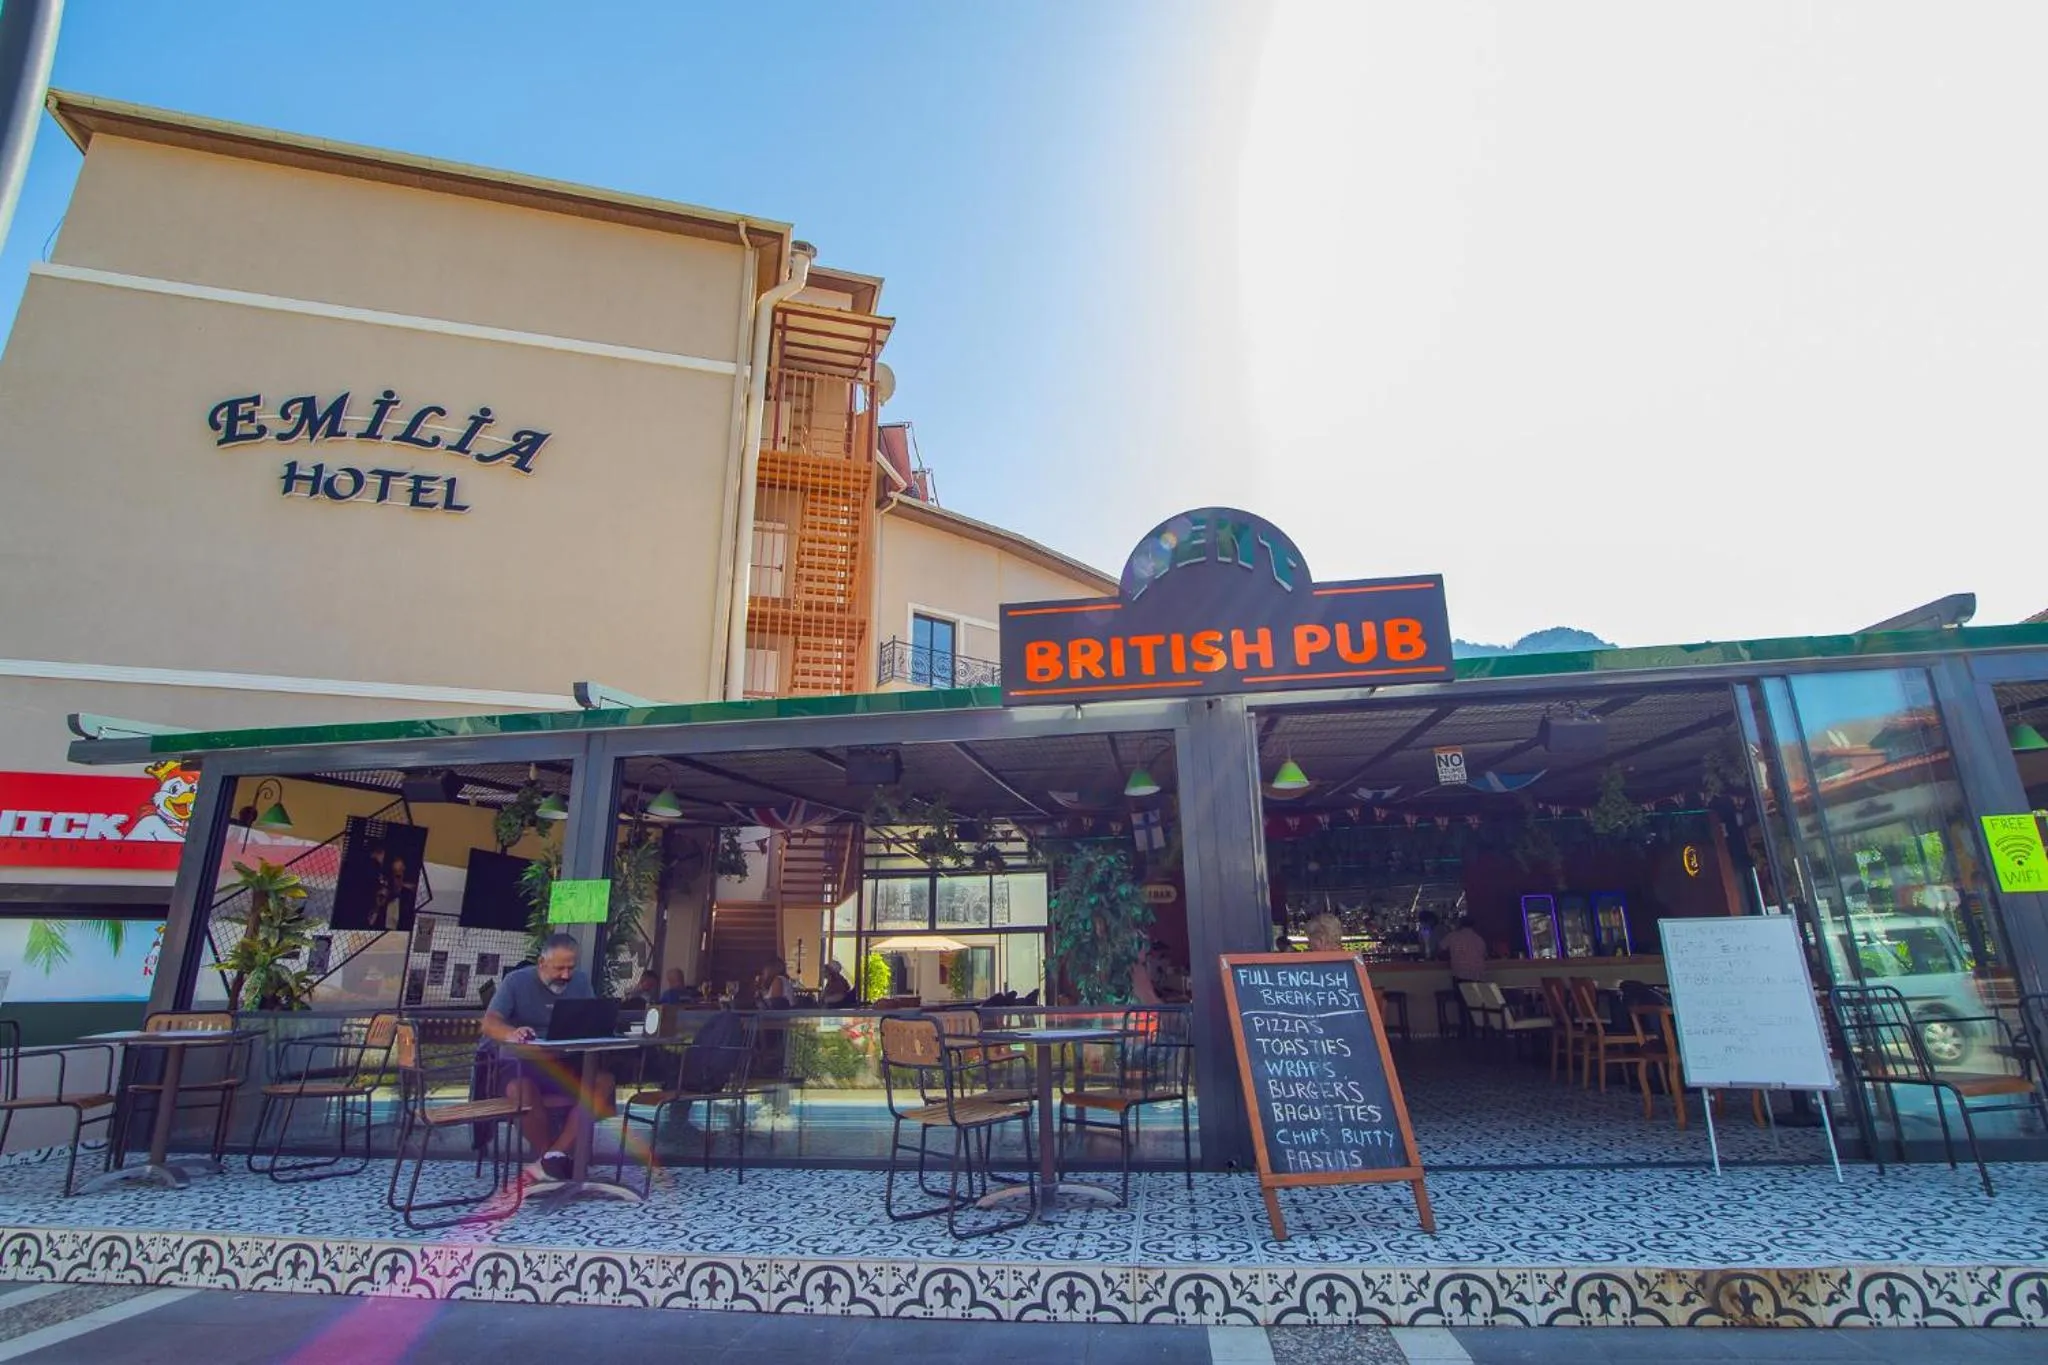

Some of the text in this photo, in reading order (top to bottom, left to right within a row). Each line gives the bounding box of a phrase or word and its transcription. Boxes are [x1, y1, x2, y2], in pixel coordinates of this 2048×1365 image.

[208, 389, 552, 474] EMİLİA
[280, 461, 471, 512] HOTEL
[1025, 618, 1428, 682] BRITISH PUB
[1437, 753, 1463, 767] NO
[1990, 817, 2030, 830] FREE
[2003, 868, 2042, 885] WIFI
[1237, 968, 1349, 988] FULL ENGLISH
[1261, 988, 1360, 1008] BREAKFAST
[1252, 1016, 1324, 1034] PIZZAS
[1256, 1038, 1351, 1057] TOASTIES
[1264, 1058, 1336, 1078] WRAPS
[1271, 1102, 1382, 1123] BAGUETTES
[1341, 1127, 1394, 1148] BUTTY
